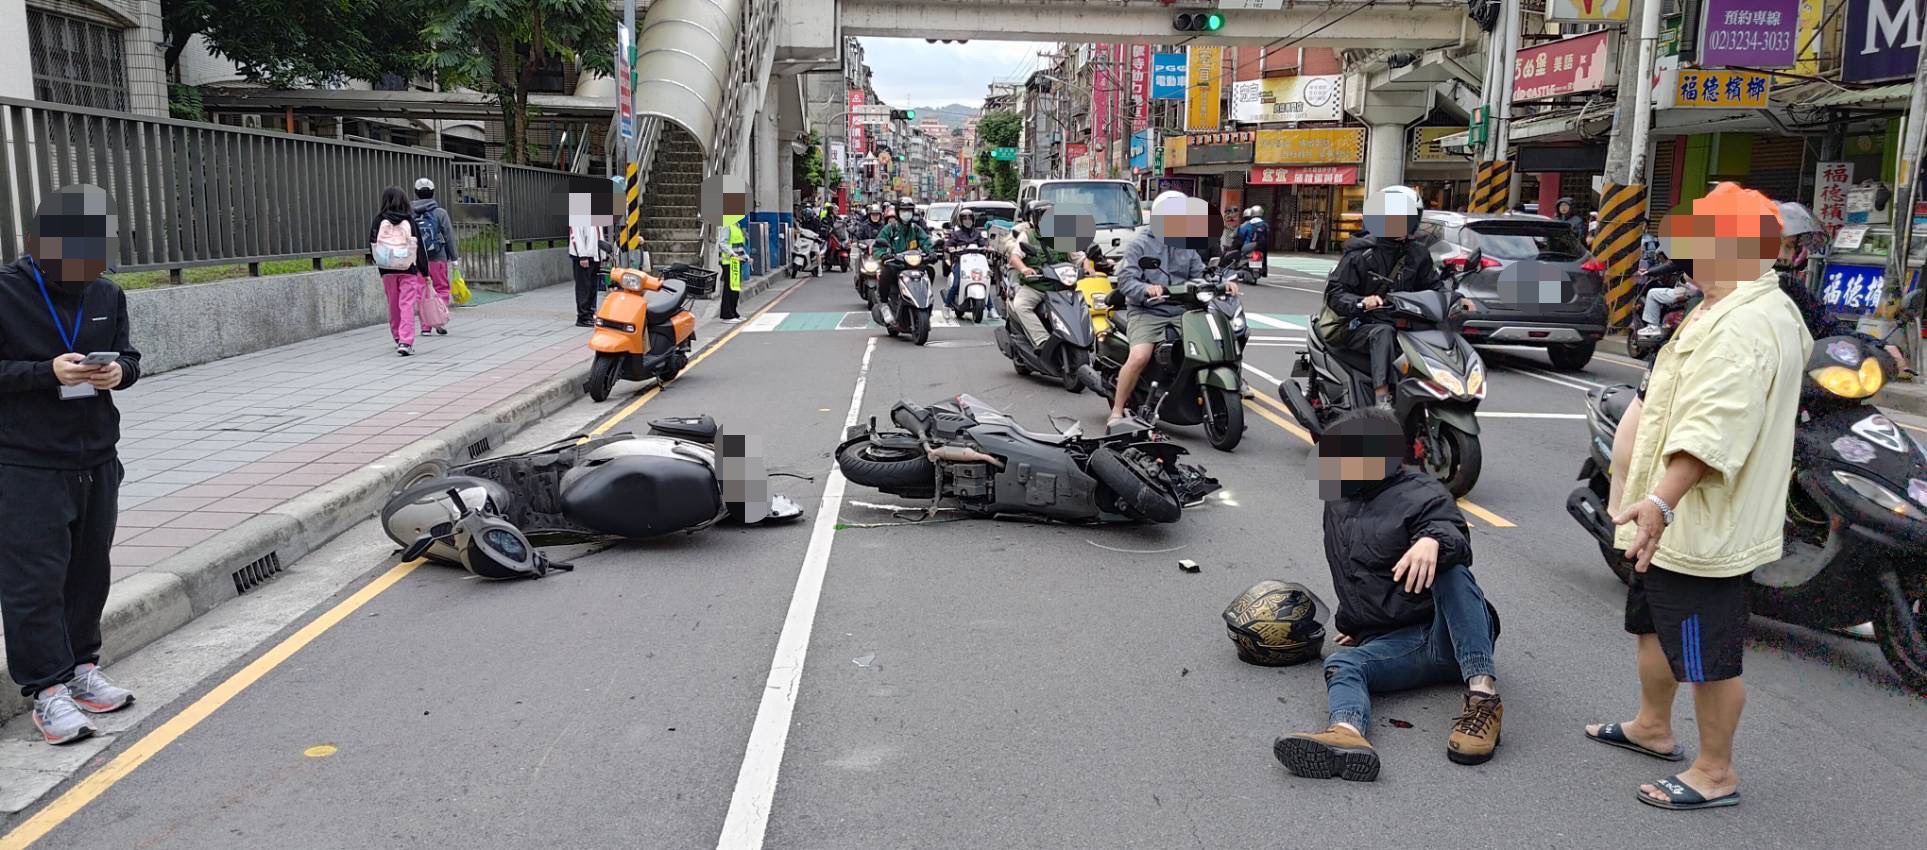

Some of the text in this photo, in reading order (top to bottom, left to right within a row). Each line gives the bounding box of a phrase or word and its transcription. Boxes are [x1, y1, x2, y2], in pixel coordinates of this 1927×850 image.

[1724, 10, 1781, 26] 預約專線
[1709, 30, 1790, 51] (02)3234-3033
[1553, 53, 1574, 72] 美語
[1155, 75, 1187, 87] 電動車
[1680, 75, 1766, 102] 福德檳榔
